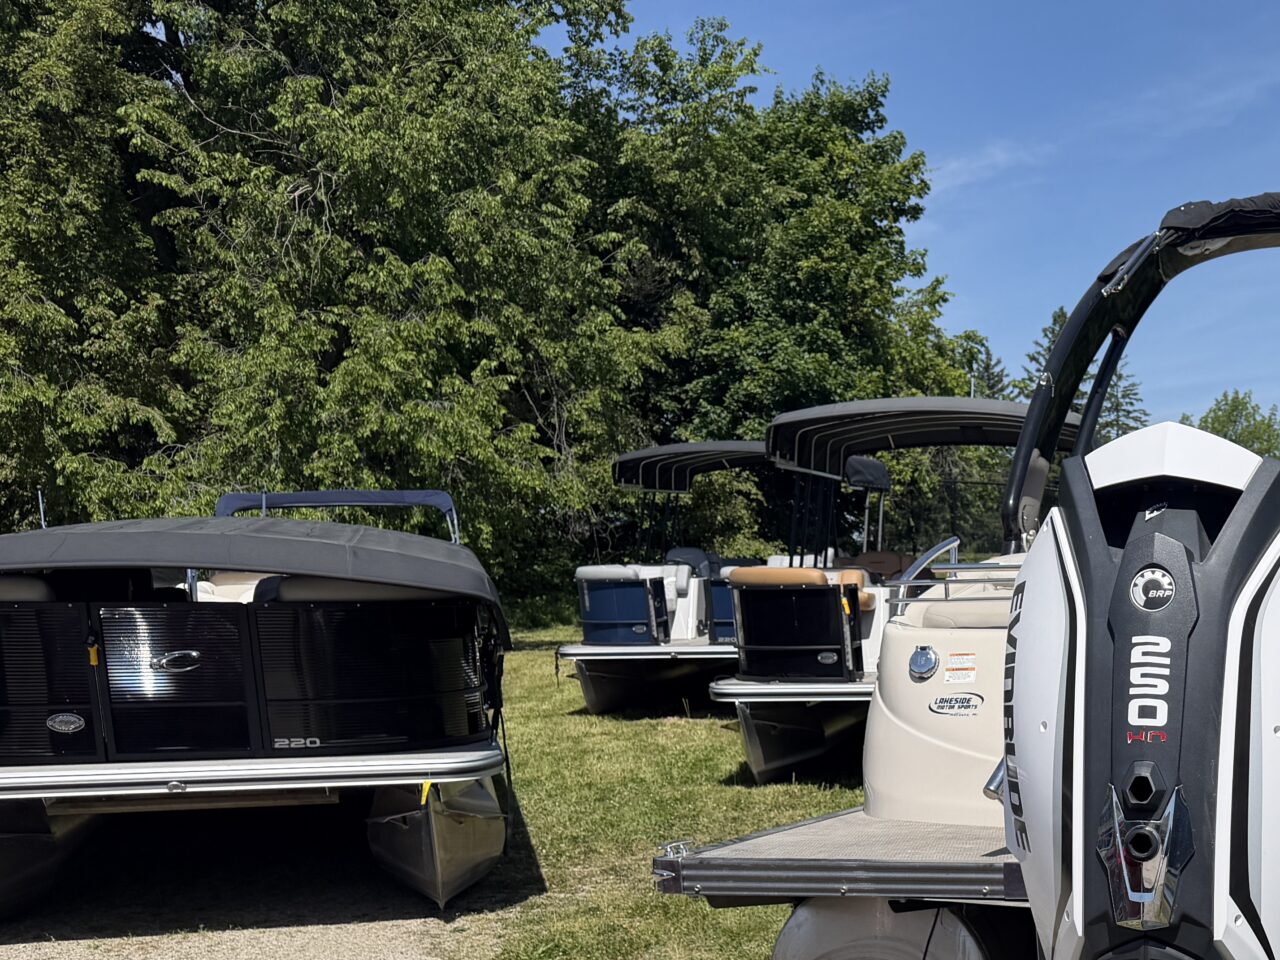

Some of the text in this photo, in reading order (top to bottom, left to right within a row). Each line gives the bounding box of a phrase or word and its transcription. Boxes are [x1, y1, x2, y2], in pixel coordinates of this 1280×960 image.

[1148, 590, 1173, 598] BRP
[1127, 635, 1172, 727] 250
[934, 697, 973, 705] LAKESIDE
[274, 737, 320, 749] 220
